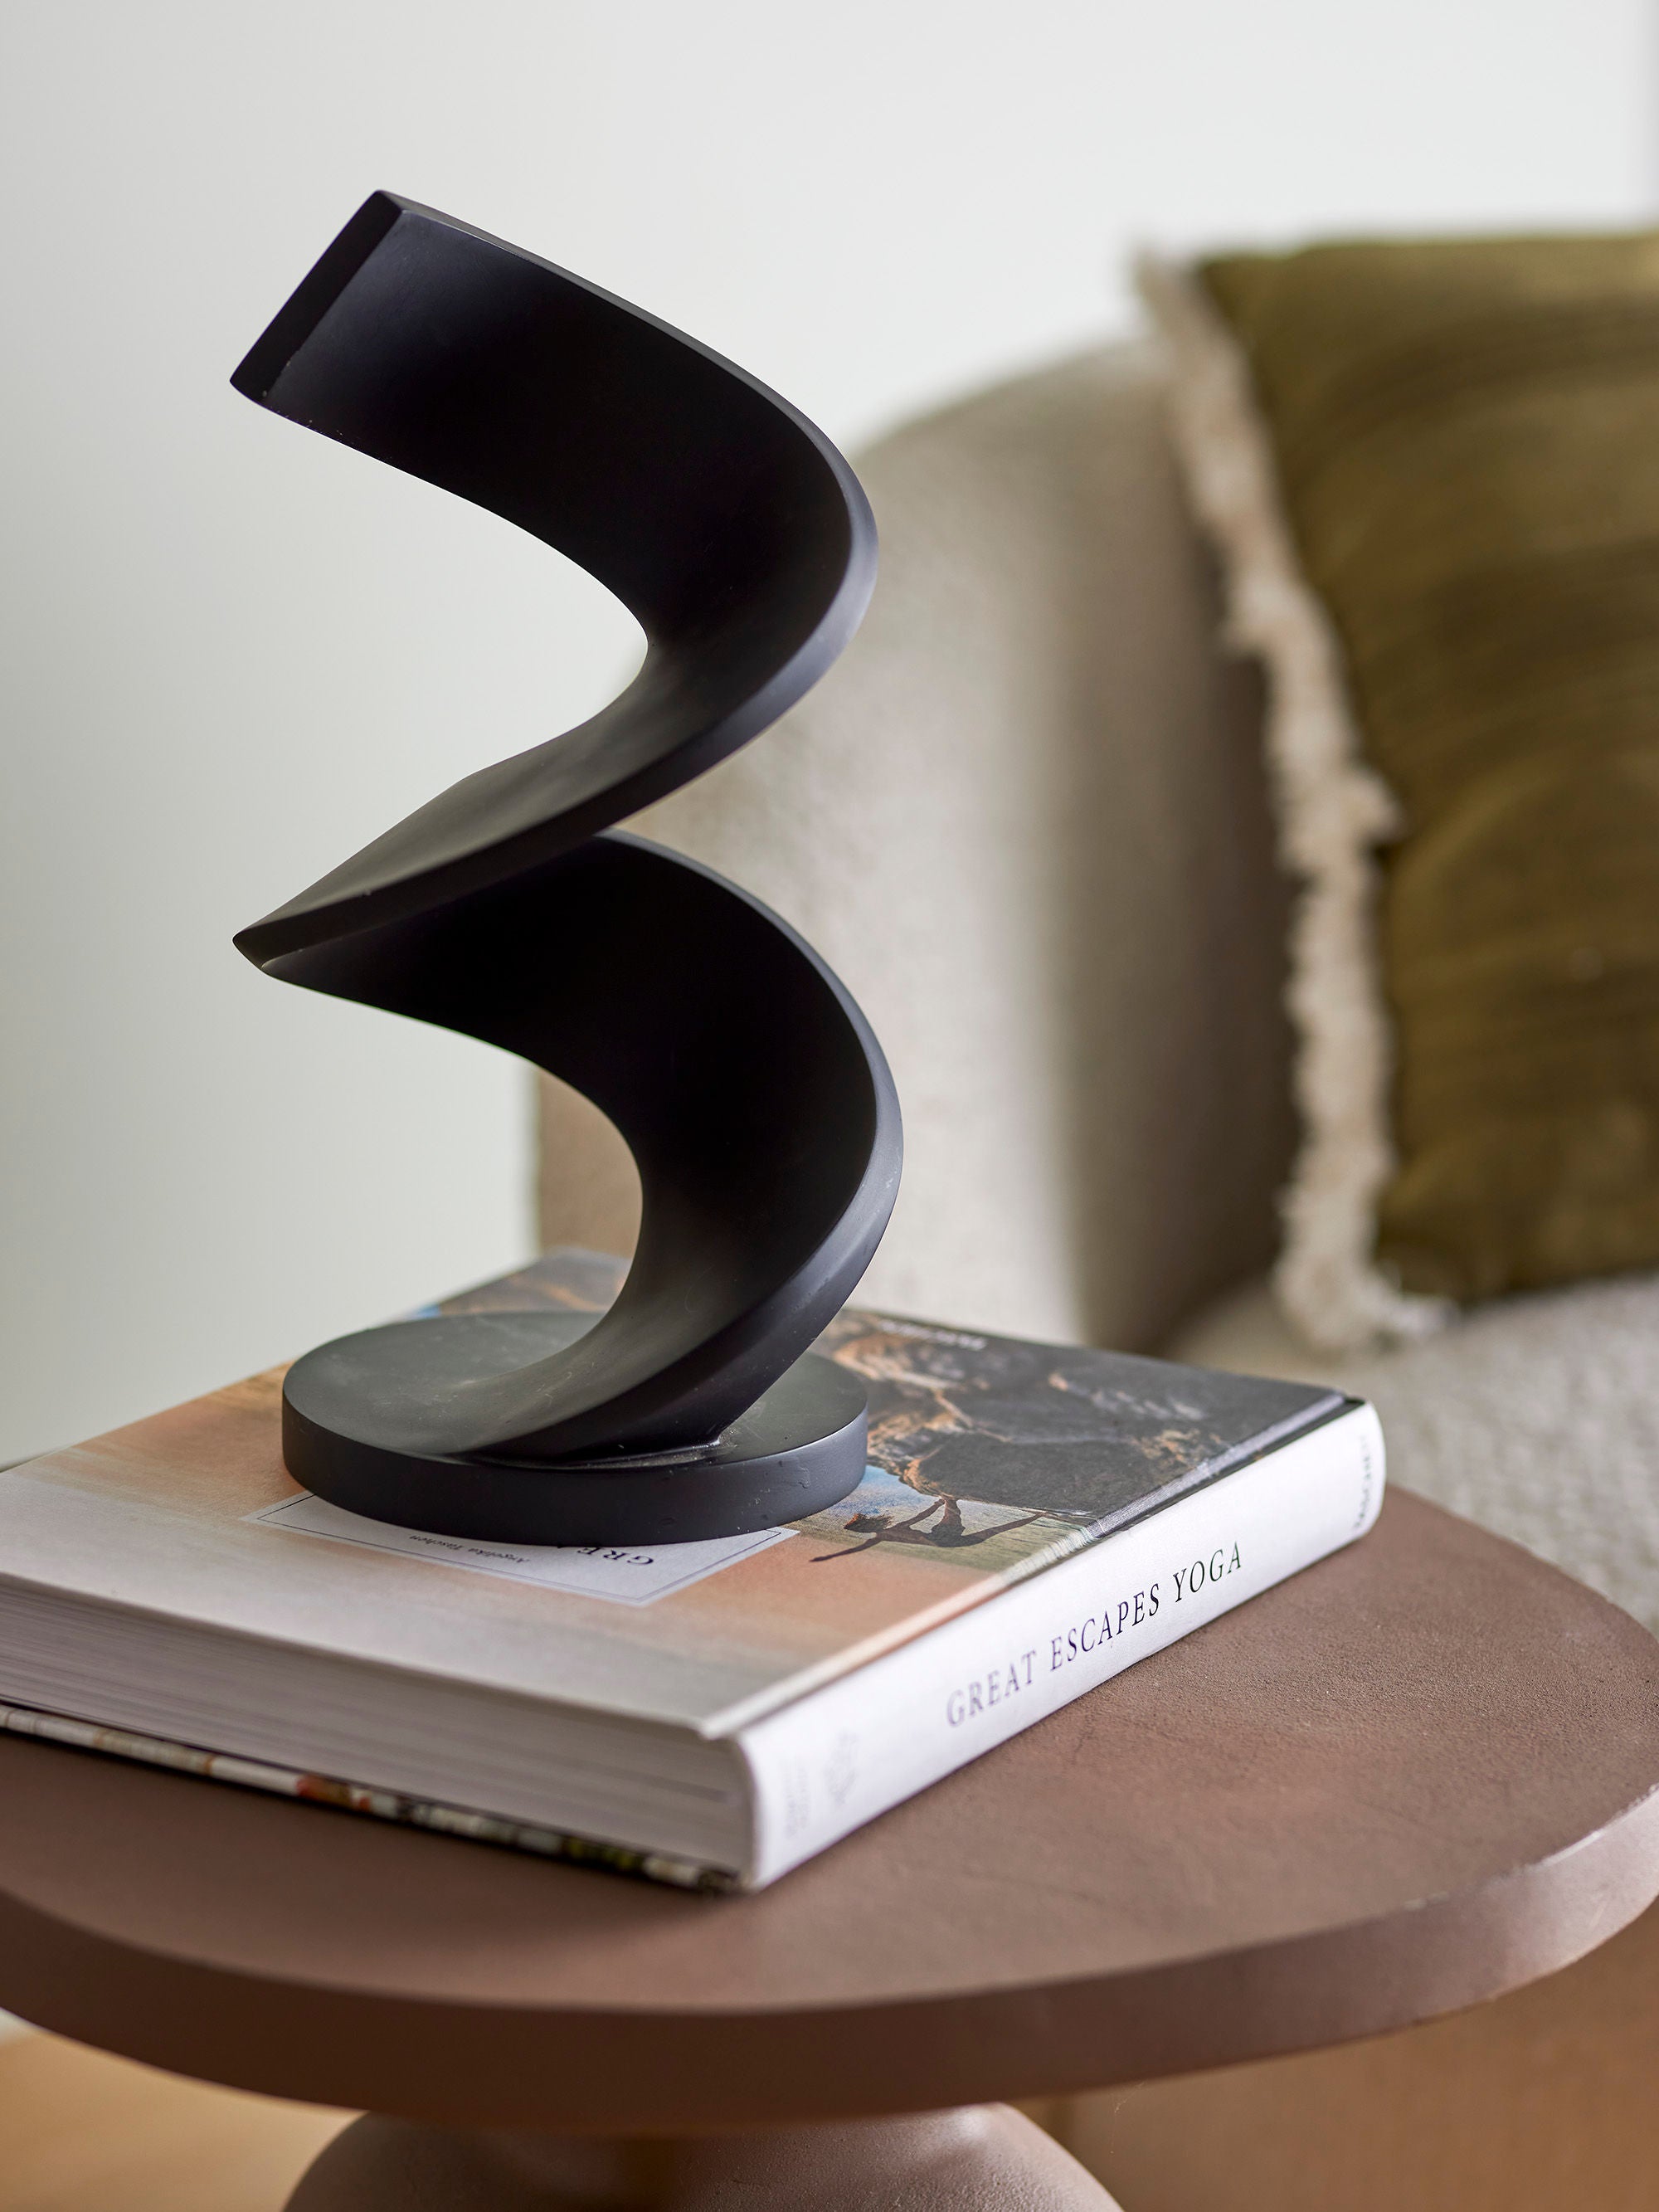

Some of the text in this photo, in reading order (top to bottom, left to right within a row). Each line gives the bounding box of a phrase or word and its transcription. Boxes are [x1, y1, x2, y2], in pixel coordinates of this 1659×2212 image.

[409, 1535, 463, 1550] Taschen
[561, 1546, 654, 1565] GRE
[946, 1541, 1242, 1727] GREAT ESCAPES YOGA
